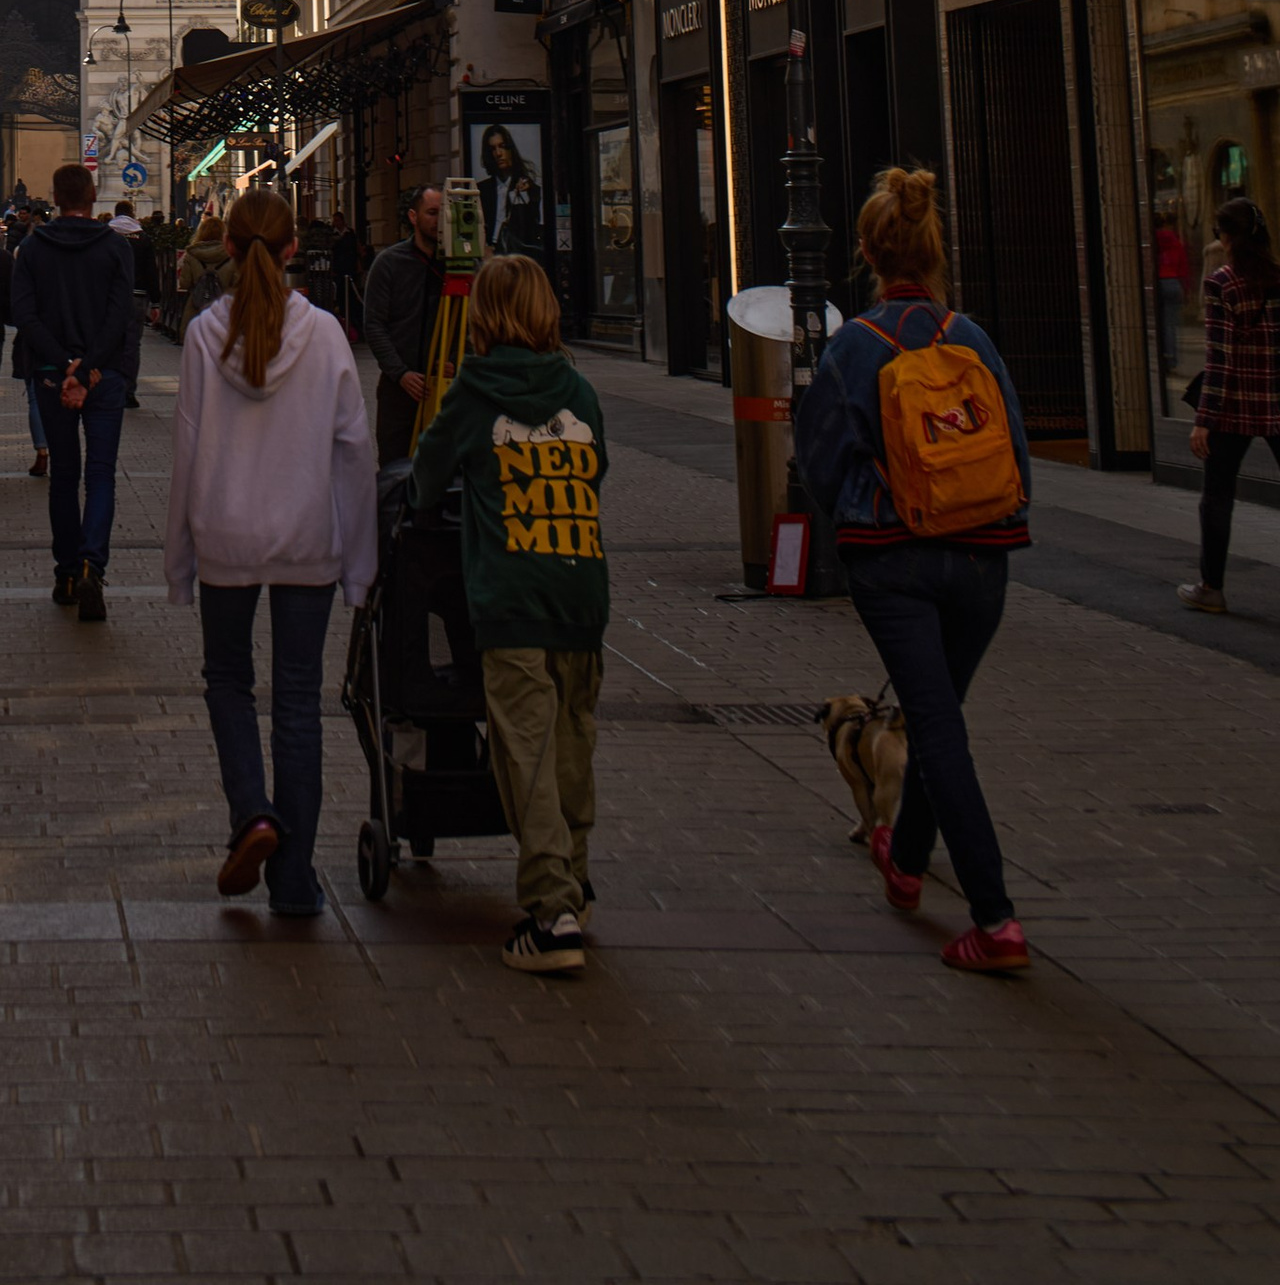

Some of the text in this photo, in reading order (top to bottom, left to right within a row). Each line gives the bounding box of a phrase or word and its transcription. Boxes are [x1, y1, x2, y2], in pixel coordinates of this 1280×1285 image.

[485, 94, 527, 105] CELINE
[492, 440, 599, 483] NED
[501, 477, 599, 518] MID
[503, 516, 604, 560] MIR
